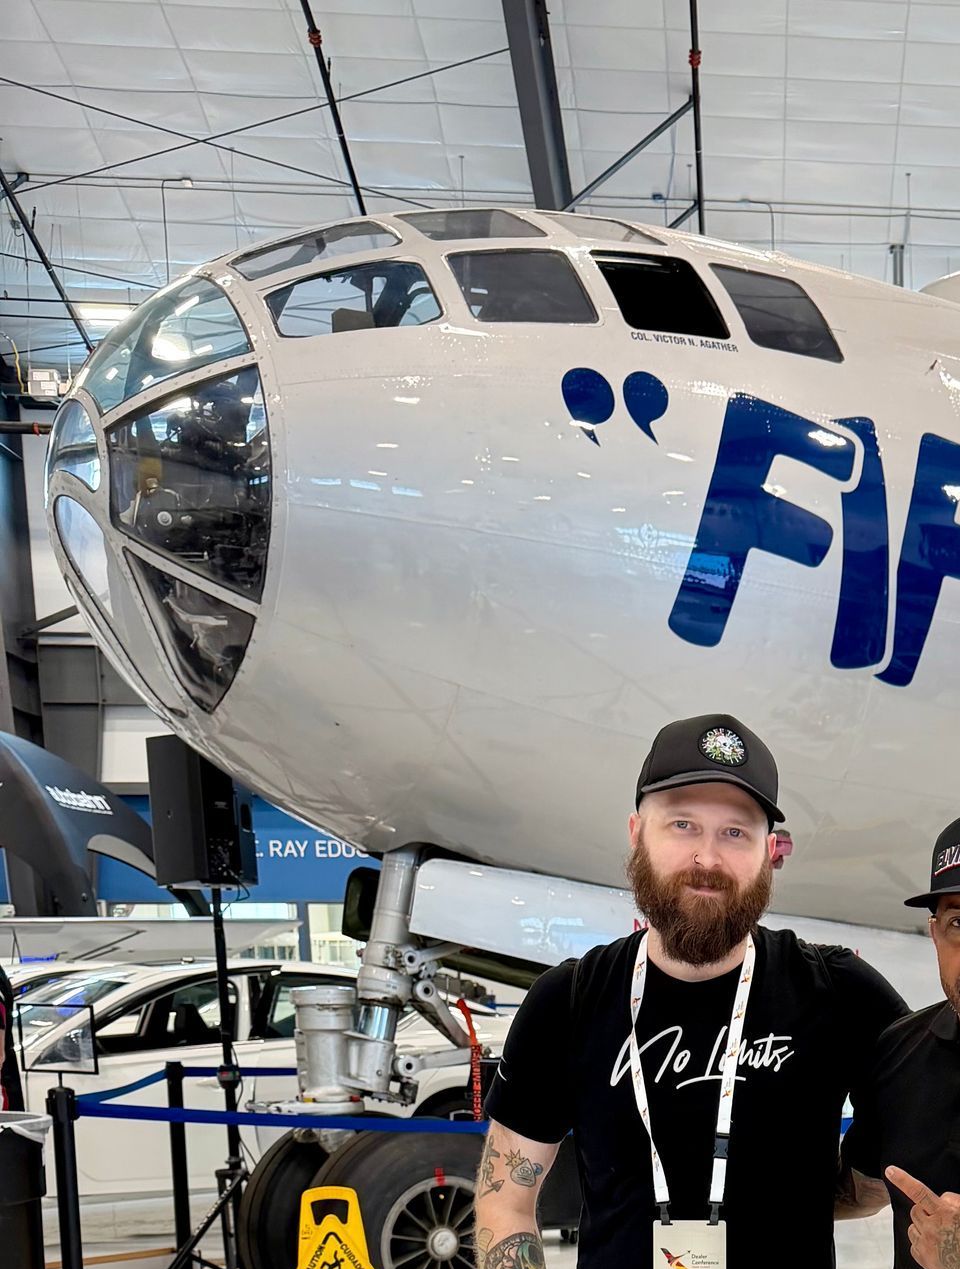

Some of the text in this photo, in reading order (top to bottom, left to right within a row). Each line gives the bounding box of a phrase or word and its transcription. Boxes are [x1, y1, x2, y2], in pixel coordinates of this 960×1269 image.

[630, 331, 739, 352] COL. VICTOR N. AGATHER
[269, 840, 308, 858] RAY
